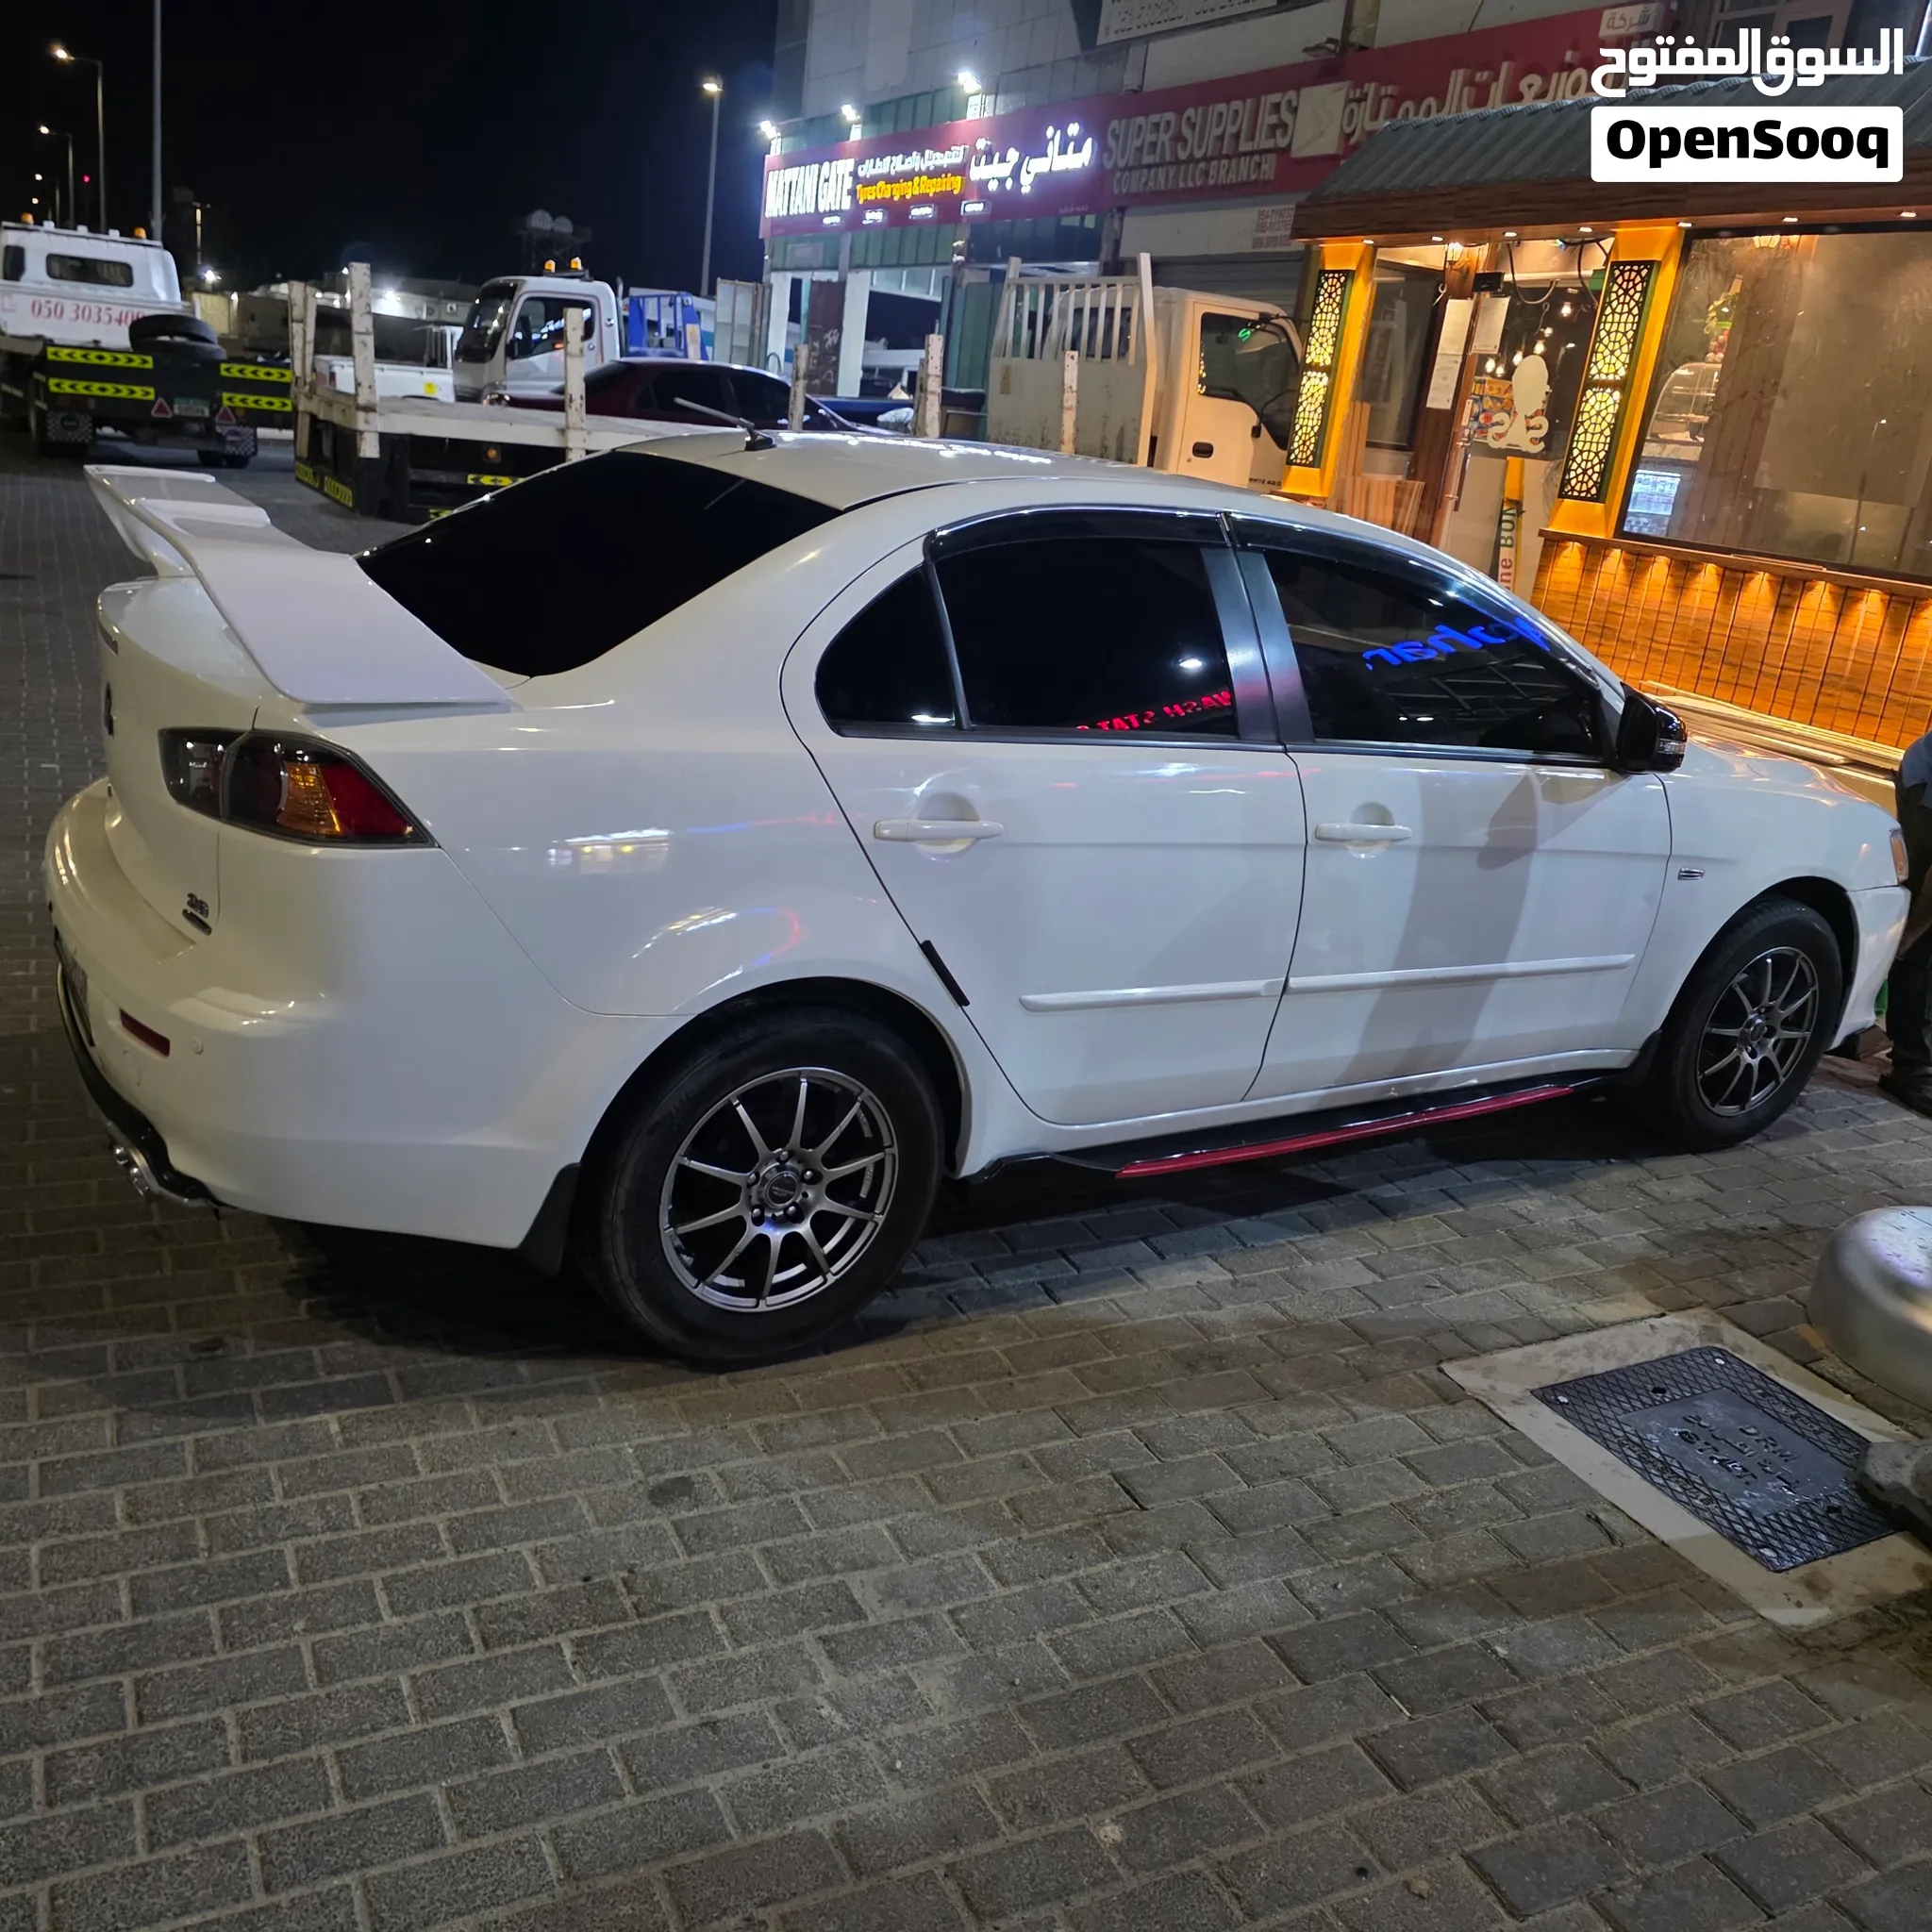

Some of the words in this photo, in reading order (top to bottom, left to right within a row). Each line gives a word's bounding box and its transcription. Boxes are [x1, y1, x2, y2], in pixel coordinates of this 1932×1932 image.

[1606, 6, 1651, 31] شركة
[1103, 111, 1176, 170] SUPER
[1177, 90, 1298, 161] SUPPLIES
[969, 137, 1021, 192] جيت
[1019, 122, 1093, 194] متاني
[1113, 165, 1178, 195] COMPANY
[1178, 161, 1208, 189] LLC
[1208, 153, 1277, 186] BRANCH
[817, 158, 856, 213] GATE
[875, 177, 913, 202] Changing
[912, 175, 921, 195] &
[920, 172, 962, 196] Repairing
[31, 298, 64, 320] 050
